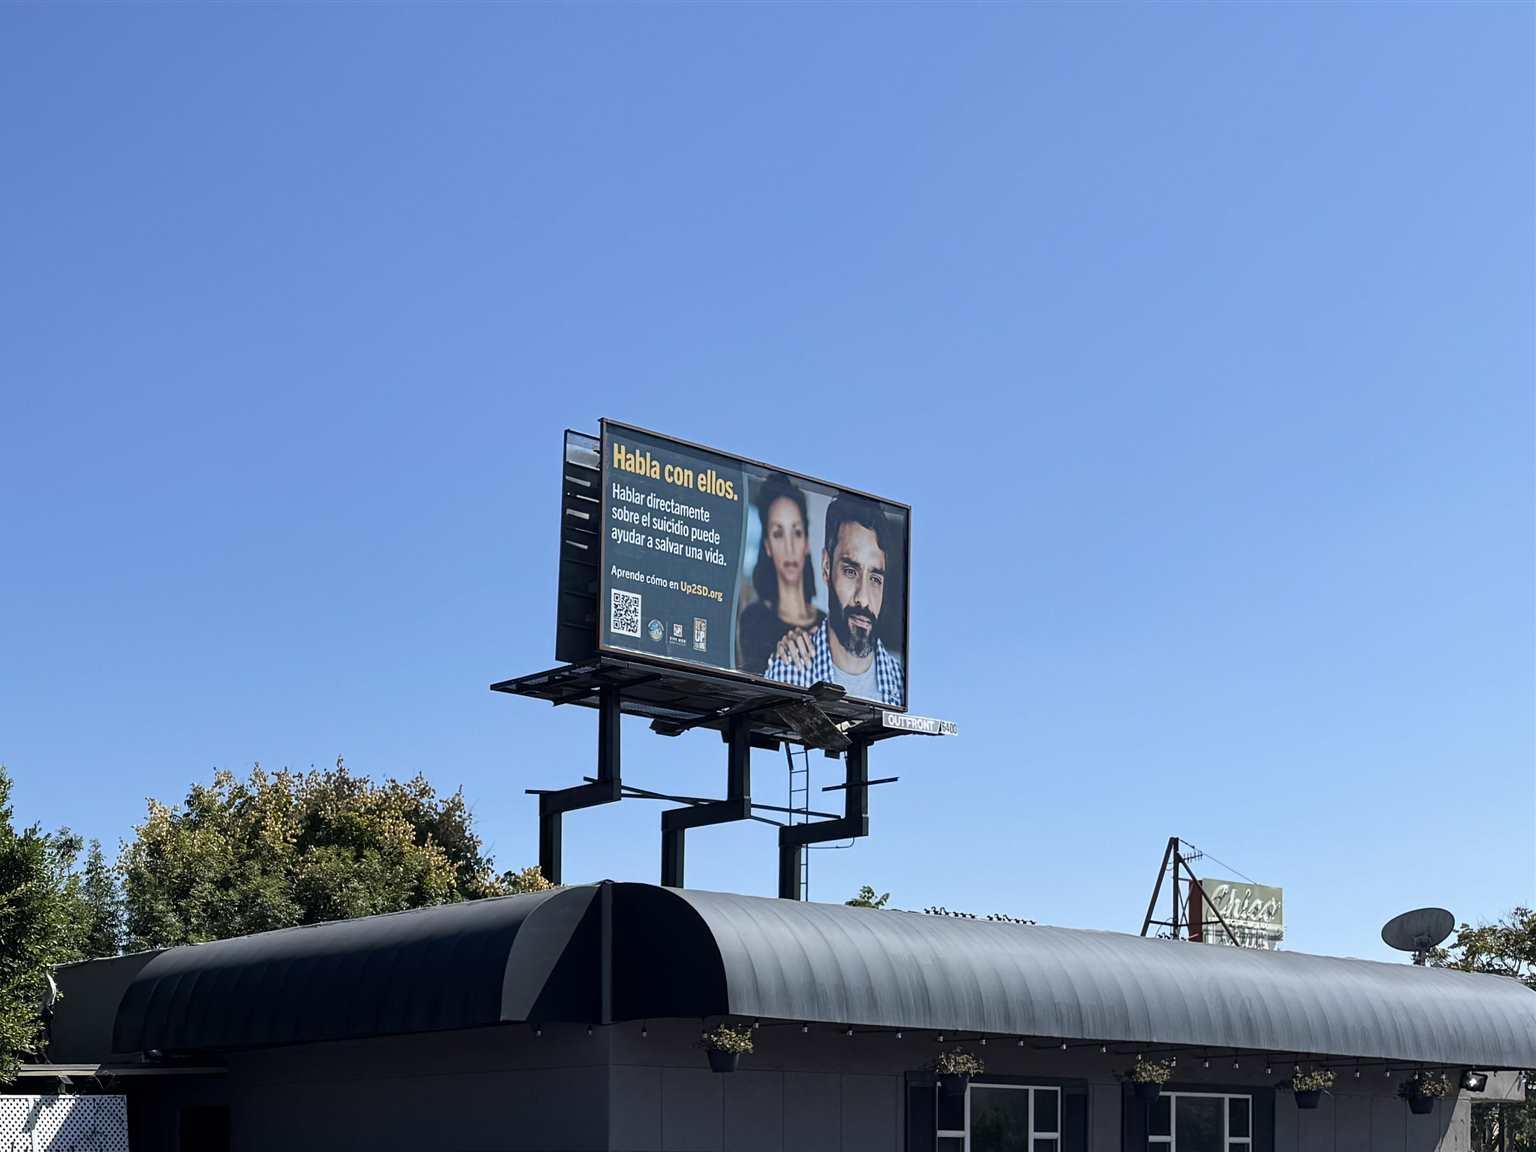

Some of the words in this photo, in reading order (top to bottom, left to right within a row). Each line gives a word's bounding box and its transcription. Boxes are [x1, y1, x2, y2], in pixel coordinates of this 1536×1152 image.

[613, 443, 660, 480] Habla
[664, 464, 693, 489] con
[697, 469, 738, 501] ellos.
[612, 482, 645, 506] Hablar
[646, 492, 710, 523] directamente
[611, 505, 640, 525] sobre
[641, 512, 651, 528] el
[652, 516, 689, 537] suicidio
[691, 527, 720, 545] puede
[611, 527, 646, 546] ayudar
[646, 536, 654, 548] a
[654, 537, 683, 556] salvar
[685, 545, 703, 560] una
[704, 547, 727, 567] vida.
[611, 565, 645, 583] Aprende
[646, 574, 668, 588] cómo
[669, 581, 680, 590] en
[680, 581, 724, 602] Up2SD.org
[694, 630, 705, 643] UP
